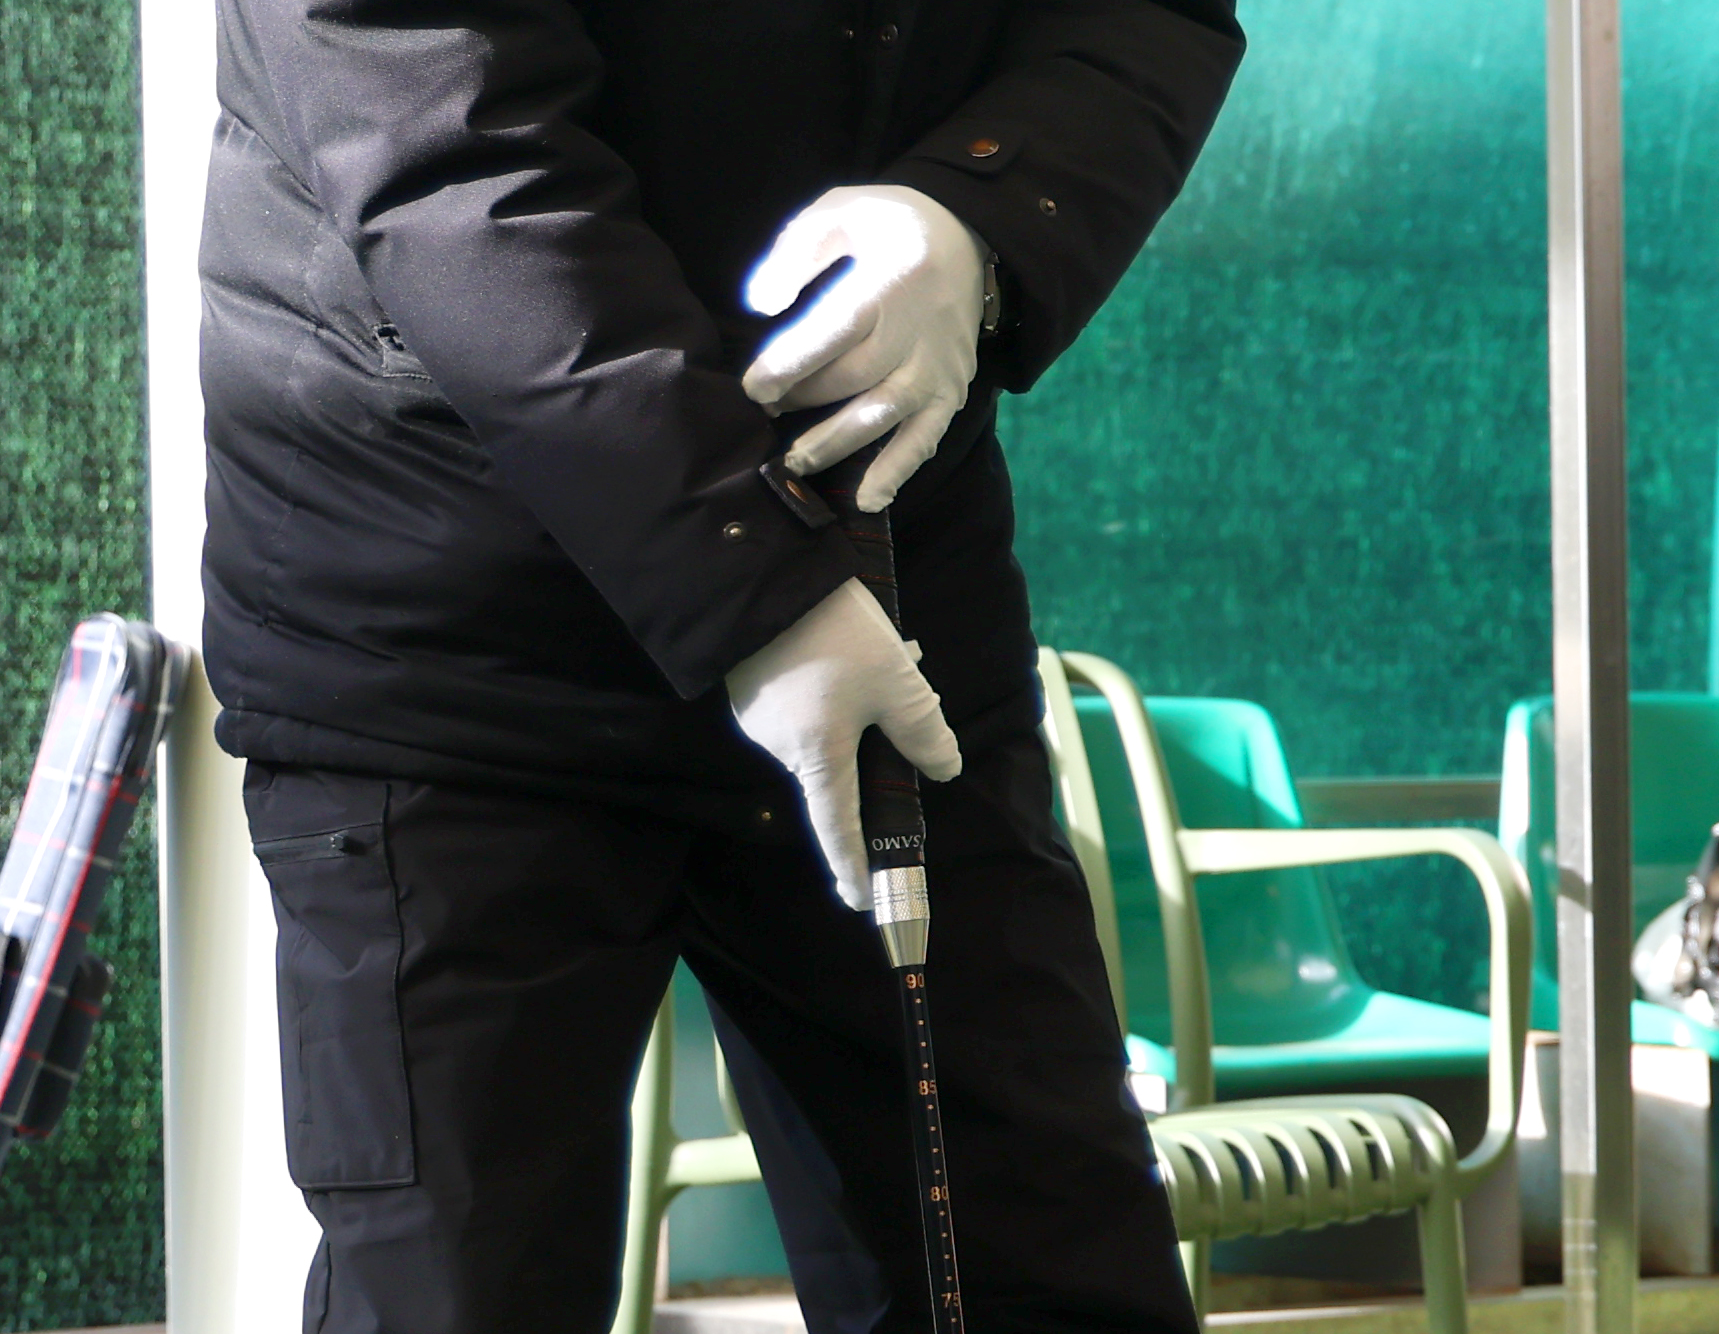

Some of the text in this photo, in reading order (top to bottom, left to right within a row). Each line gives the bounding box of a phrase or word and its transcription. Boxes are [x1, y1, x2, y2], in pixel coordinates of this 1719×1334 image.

[871, 834, 922, 852] SAMO
[905, 973, 925, 989] 90
[918, 1080, 937, 1096] 85
[930, 1185, 949, 1202] 80
[941, 1292, 960, 1308] 75
